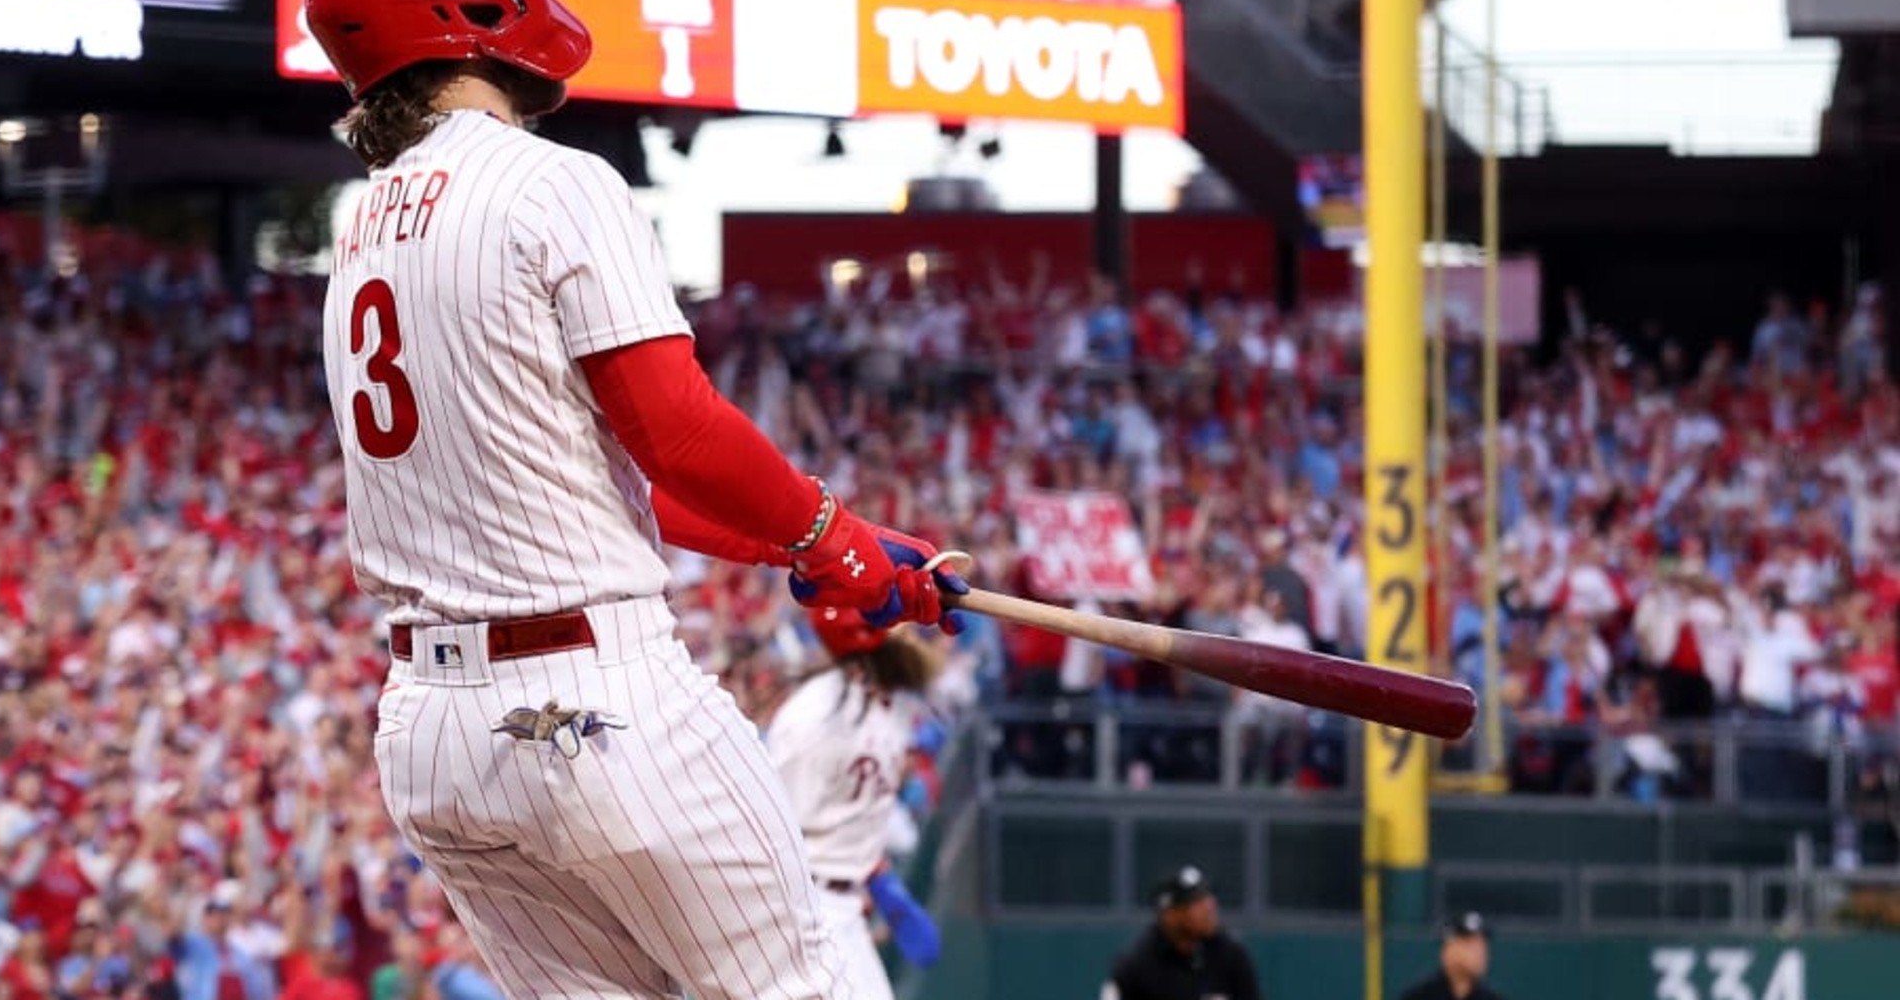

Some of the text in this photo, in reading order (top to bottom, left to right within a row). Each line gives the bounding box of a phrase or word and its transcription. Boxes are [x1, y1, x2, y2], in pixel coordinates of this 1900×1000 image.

[874, 7, 1163, 107] TOYOTA
[350, 278, 420, 461] 3
[1650, 947, 1807, 1000] 334
